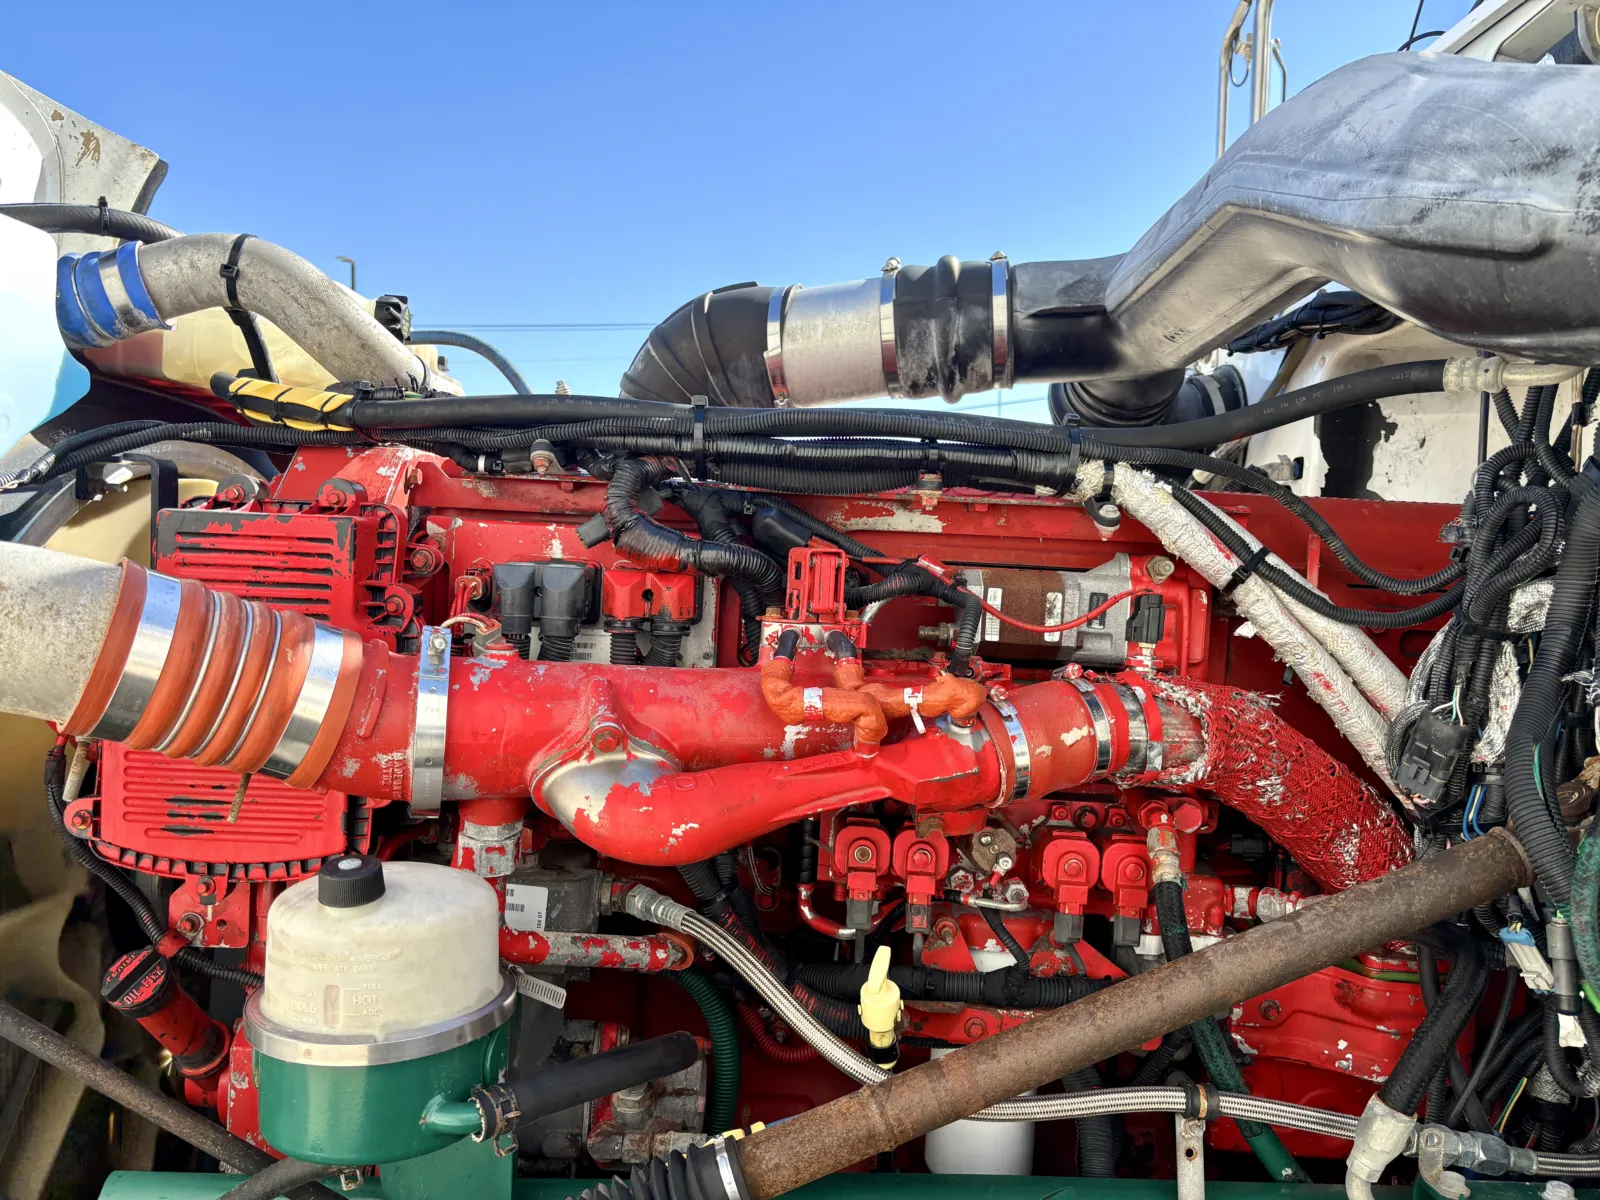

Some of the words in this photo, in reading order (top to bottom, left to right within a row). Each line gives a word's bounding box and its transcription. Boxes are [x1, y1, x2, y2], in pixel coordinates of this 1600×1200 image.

[362, 983, 382, 991] FULL
[352, 994, 379, 1005] HOT
[290, 1001, 317, 1014] COLD
[362, 1008, 381, 1016] ADD
